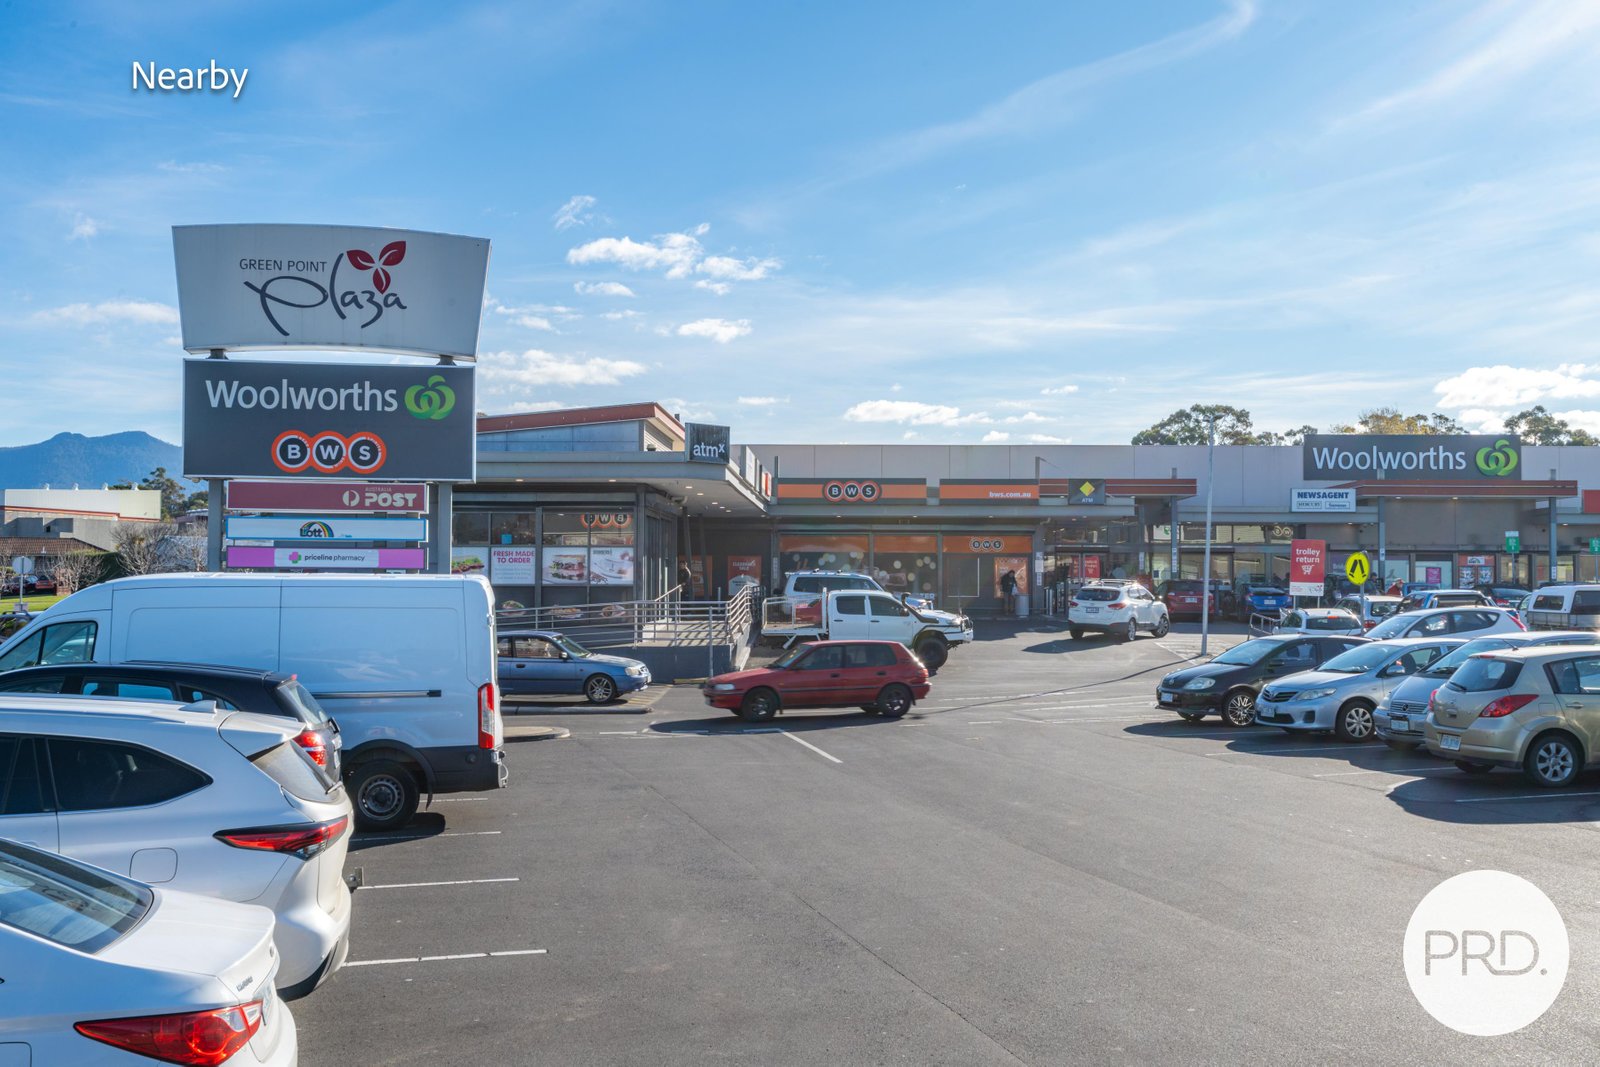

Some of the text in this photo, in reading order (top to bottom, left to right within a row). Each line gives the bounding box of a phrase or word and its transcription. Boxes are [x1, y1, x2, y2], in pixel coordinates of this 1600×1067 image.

[239, 258, 327, 272] GREEN POINT
[205, 378, 398, 412] Woolworths
[1312, 445, 1467, 470] Woolworths
[364, 492, 417, 507] POST
[1297, 491, 1350, 499] NEWSAGENT
[304, 554, 333, 562] priceline
[1295, 548, 1321, 557] trolley
